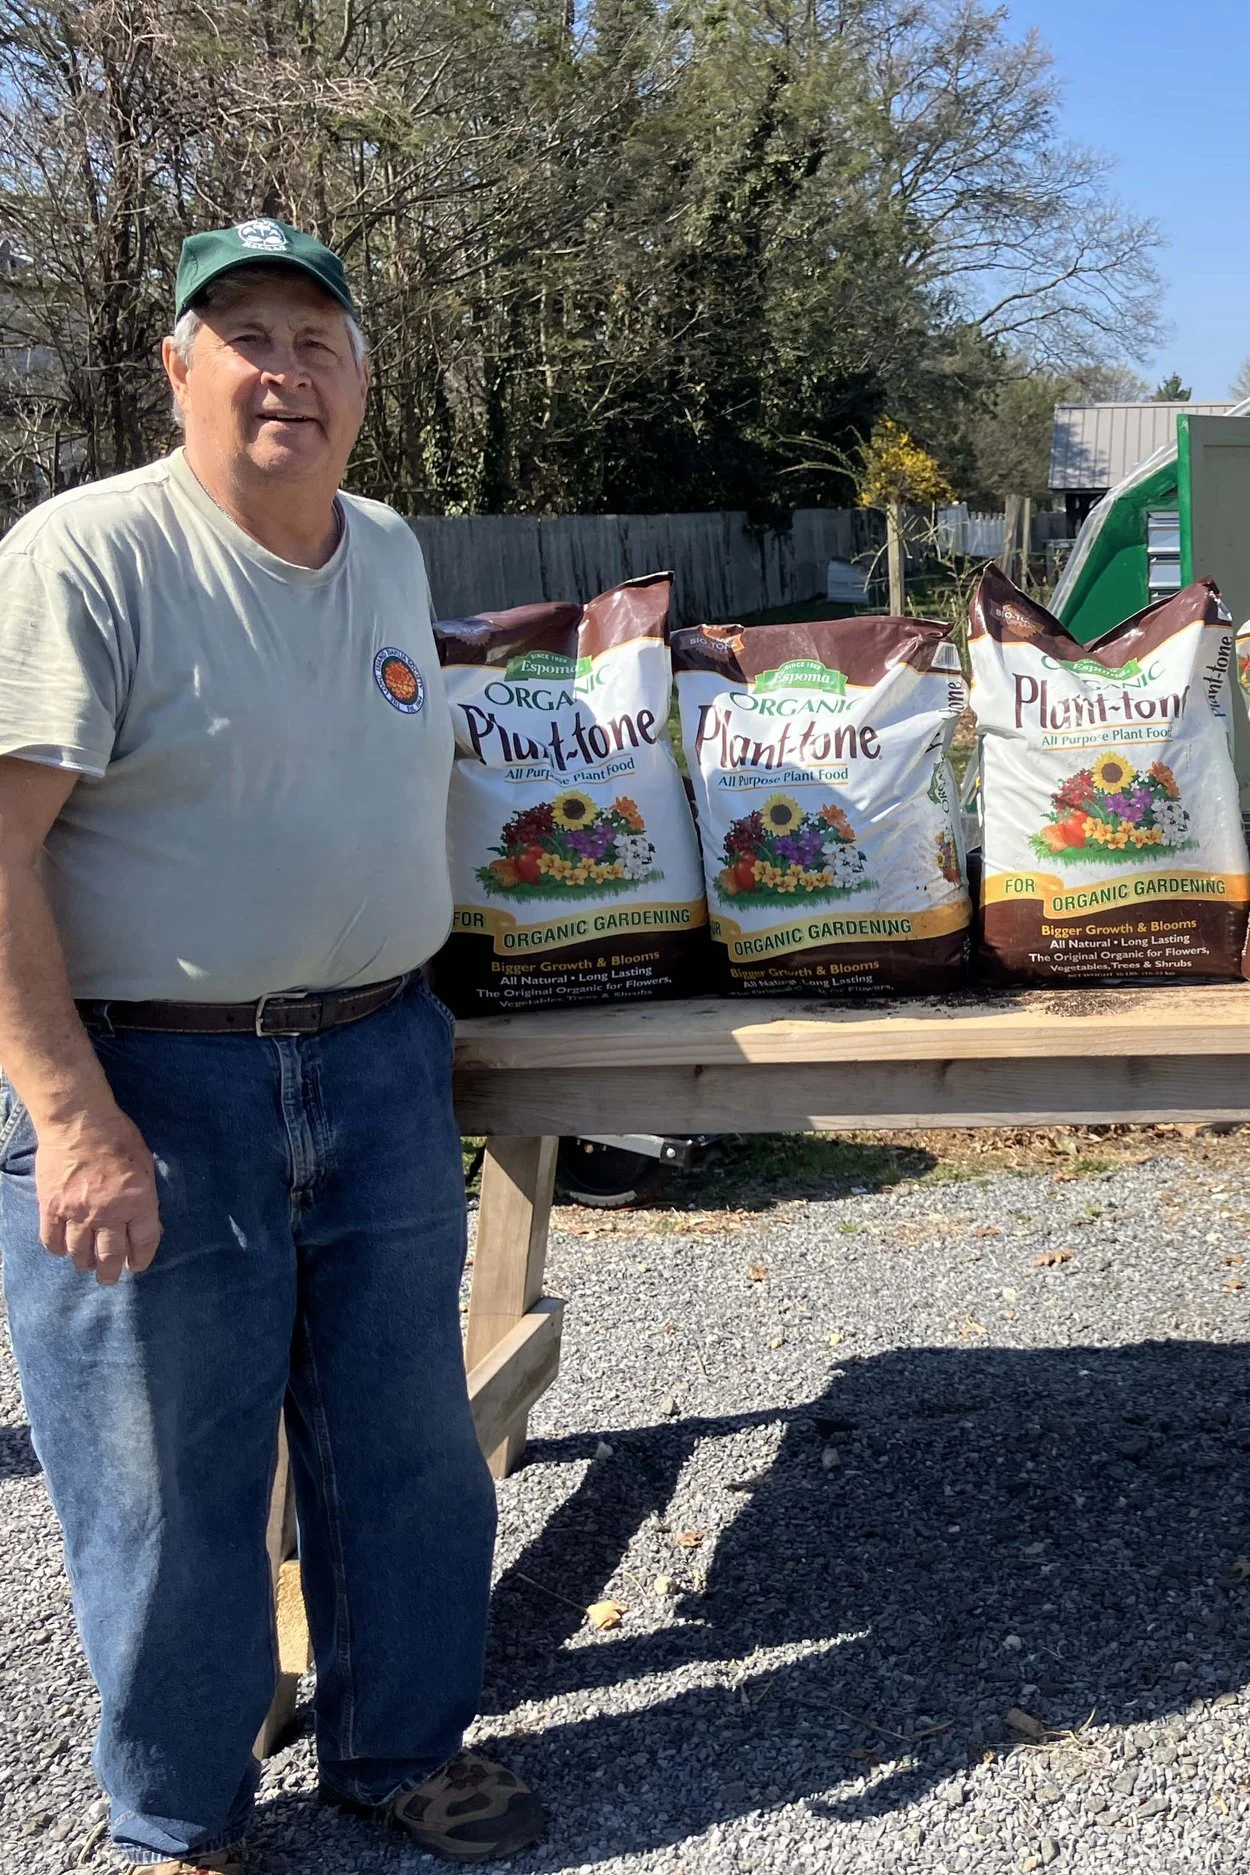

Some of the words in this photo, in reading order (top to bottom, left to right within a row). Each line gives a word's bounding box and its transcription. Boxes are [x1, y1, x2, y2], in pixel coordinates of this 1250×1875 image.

[1013, 673, 1191, 730] Plant-ton
[1041, 736, 1057, 747] All
[1062, 733, 1109, 746] Purpoe
[1112, 729, 1143, 741] Plant
[505, 768, 523, 780] All
[574, 770, 605, 783] Plant
[606, 758, 635, 776] Food
[718, 776, 736, 788] All
[738, 774, 781, 788] Purpose
[783, 771, 815, 783] Plant
[818, 767, 849, 781] Food
[1005, 878, 1035, 893] FOR
[1053, 884, 1128, 911] ORGANIC
[1134, 878, 1226, 895] GARDENING
[504, 920, 587, 948] ORGANIC
[594, 909, 690, 932] GARDENING
[734, 928, 803, 956] ORGANIC
[808, 918, 912, 939] GARDENING
[1041, 925, 1082, 939] Bigger
[1086, 924, 1134, 936] Growth
[1137, 922, 1147, 933] &
[1151, 919, 1197, 932] Blooms
[1050, 939, 1069, 949] All
[1072, 938, 1111, 949] Natural
[1121, 937, 1148, 948] Long
[1151, 934, 1190, 945] Lasting
[491, 961, 536, 975] Bigger
[540, 960, 593, 972] Growth
[596, 957, 607, 968] &
[611, 951, 660, 966] Blooms
[1029, 953, 1051, 963] The
[1053, 952, 1098, 963] Original
[1101, 950, 1144, 962] Organic
[1147, 948, 1163, 958] for
[1166, 945, 1210, 956] Flowers,
[500, 976, 518, 985] All
[521, 975, 568, 985] Natural
[578, 973, 609, 983] Long
[611, 966, 652, 979] Lasting
[730, 967, 766, 980] Bigger
[816, 965, 826, 975] &
[830, 960, 880, 974] Blooms
[1050, 962, 1110, 973] Vegetables,
[1111, 961, 1140, 969] Trees
[1154, 958, 1192, 968] Shrubs
[476, 989, 500, 998] The
[504, 988, 552, 999] Original
[556, 984, 603, 995] Organic
[606, 981, 622, 991] for
[626, 977, 672, 988] Flowers,
[832, 975, 873, 987] Lasting
